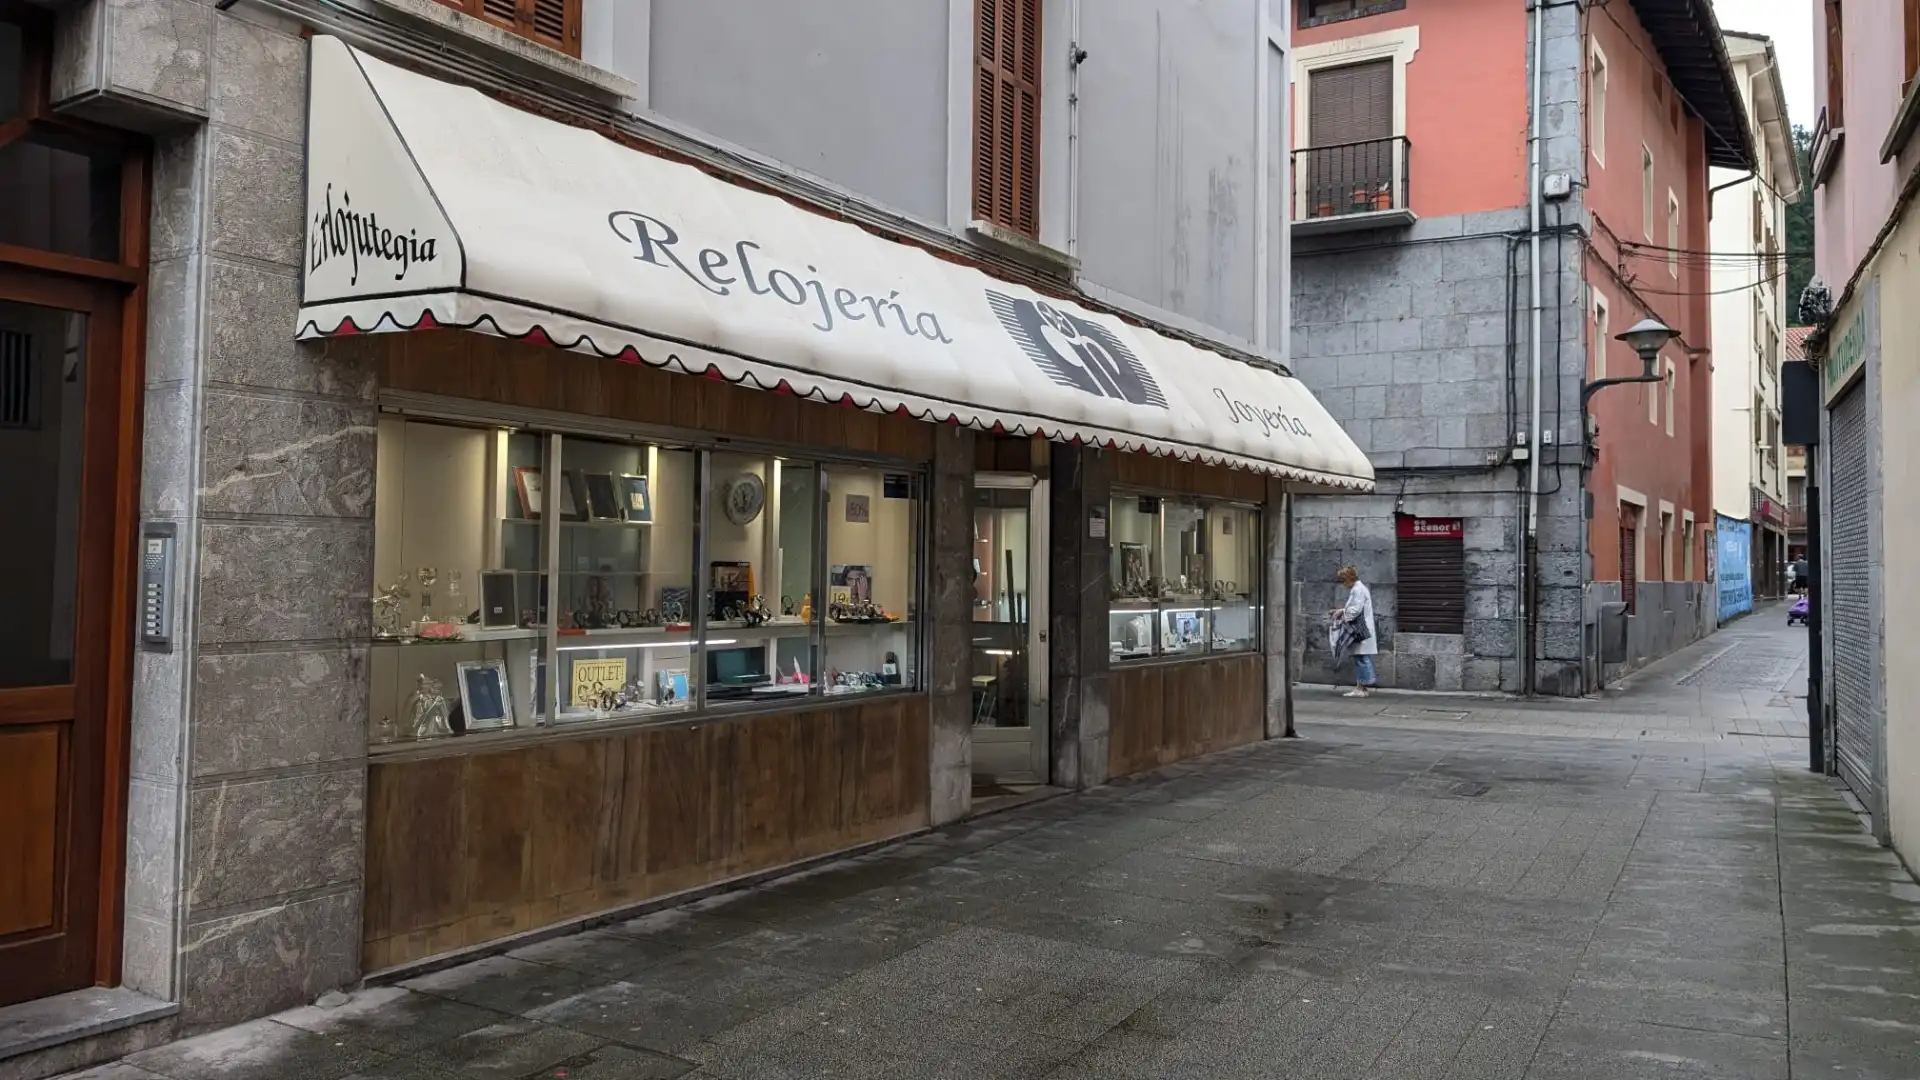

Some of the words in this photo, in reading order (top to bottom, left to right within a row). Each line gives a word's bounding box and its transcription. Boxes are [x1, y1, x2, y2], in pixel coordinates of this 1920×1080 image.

[310, 183, 437, 286] Erlojutegia
[608, 210, 953, 344] Relojería
[1213, 387, 1312, 438] Joyería
[578, 665, 622, 682] OUTLET
